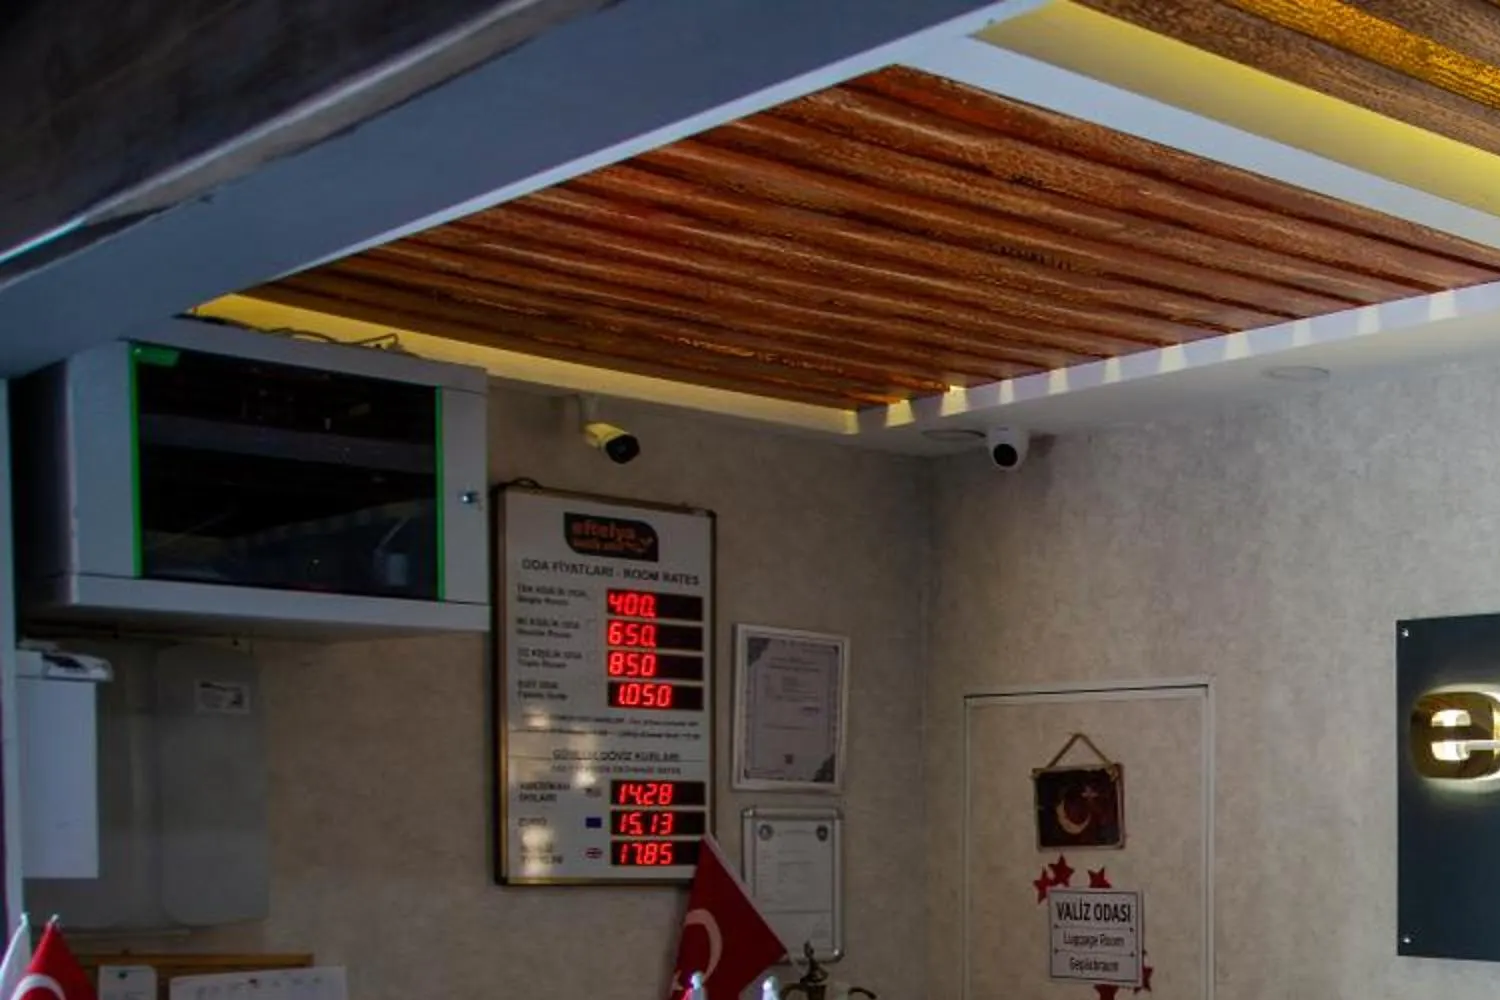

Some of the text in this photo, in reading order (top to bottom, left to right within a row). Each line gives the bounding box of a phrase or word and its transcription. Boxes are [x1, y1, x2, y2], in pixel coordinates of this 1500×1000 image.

[521, 558, 549, 571] ODA
[623, 569, 659, 582] ROOM
[662, 572, 700, 586] RATES
[609, 651, 656, 676] 850
[1055, 898, 1131, 923] VALİZ ODASI
